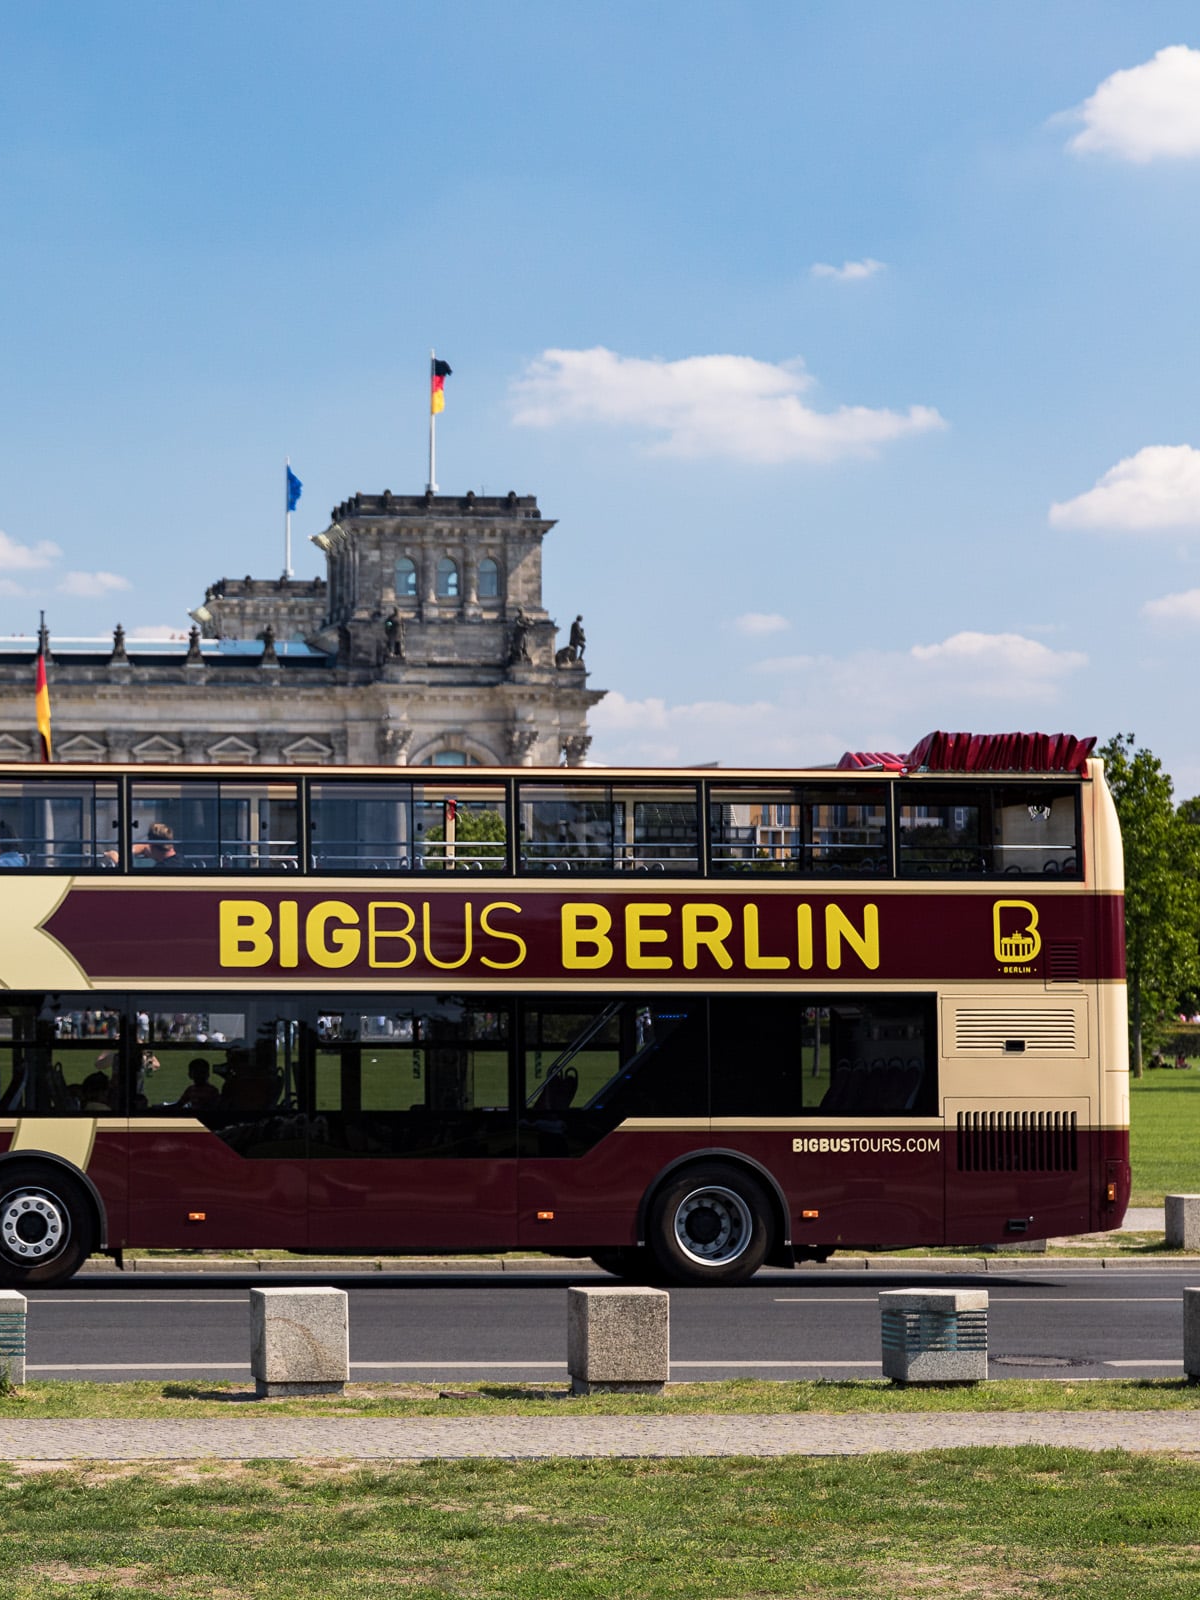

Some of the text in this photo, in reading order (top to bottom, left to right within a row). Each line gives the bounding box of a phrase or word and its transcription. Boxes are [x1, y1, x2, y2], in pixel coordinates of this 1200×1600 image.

[219, 900, 880, 970] BIGBUS BERLIN
[792, 1138, 940, 1153] BIGBUSTOURS.COM
